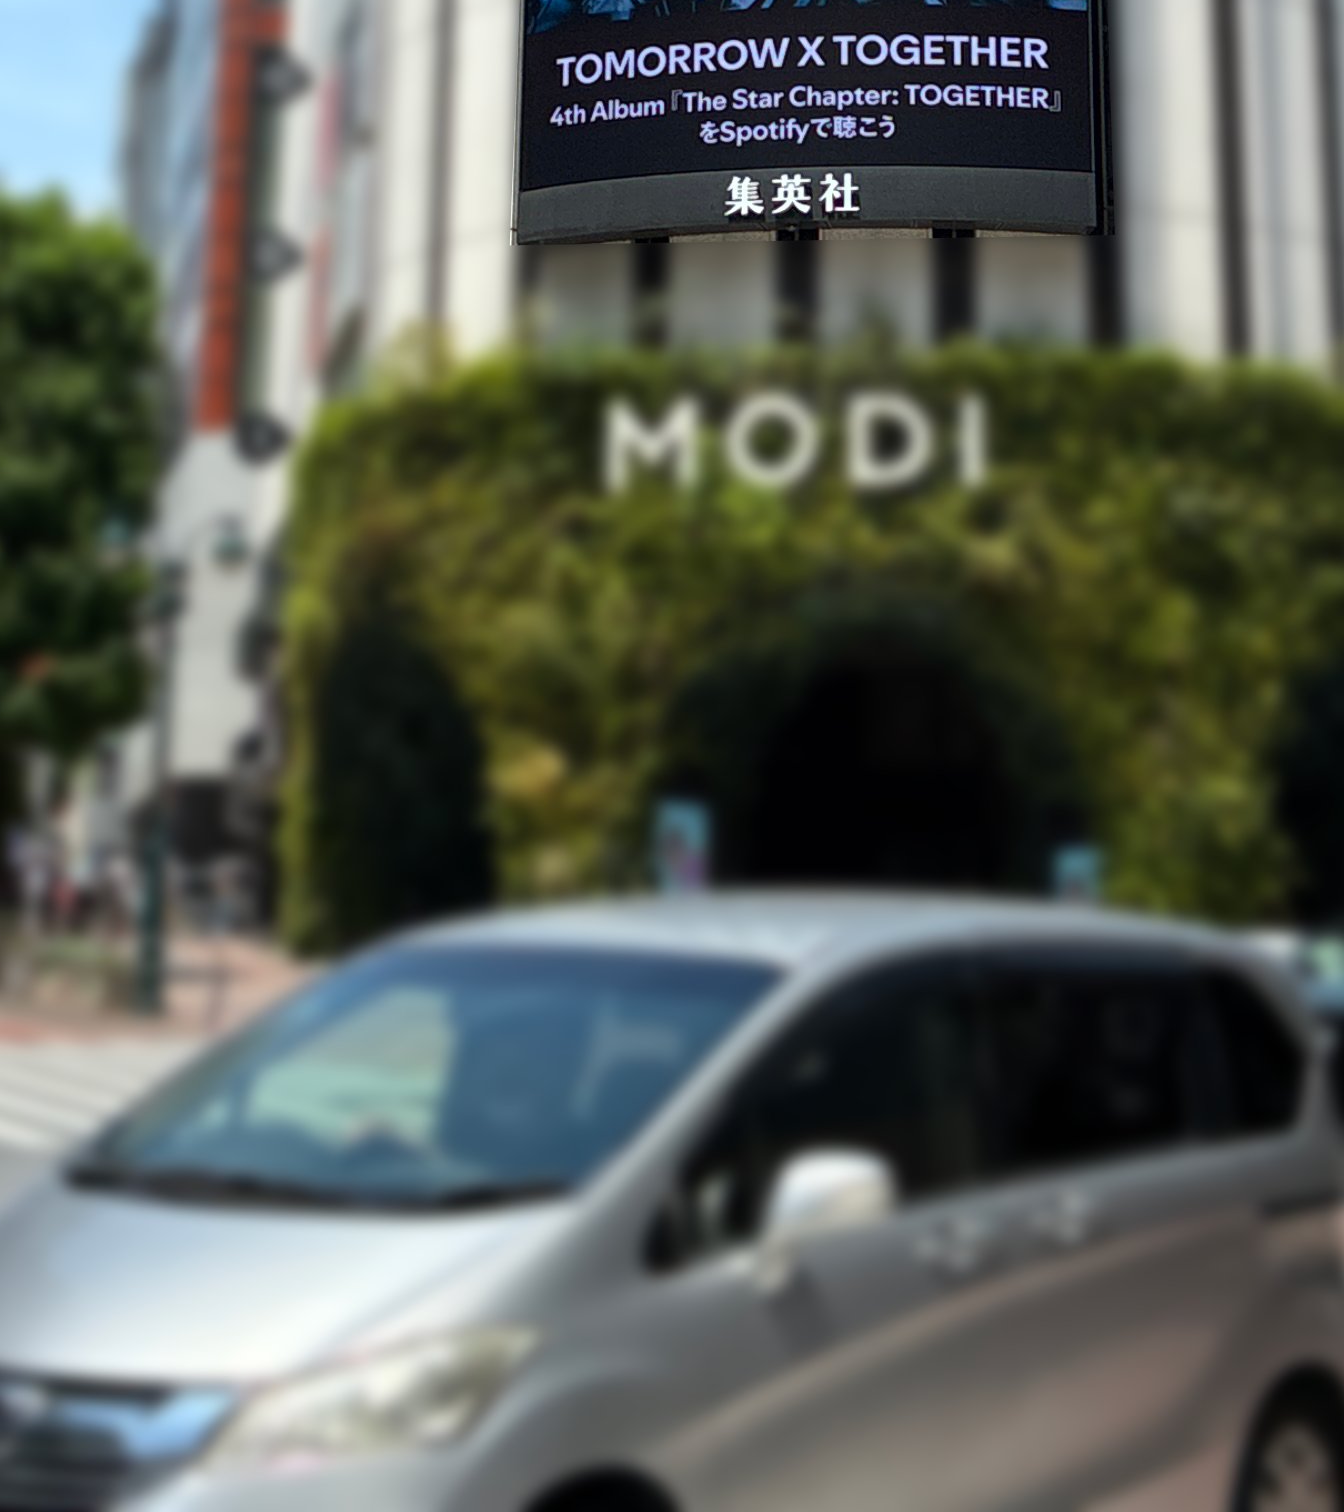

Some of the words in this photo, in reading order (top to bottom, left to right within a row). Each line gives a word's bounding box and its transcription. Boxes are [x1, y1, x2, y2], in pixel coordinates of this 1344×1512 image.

[556, 37, 790, 87] TOMORROW
[797, 36, 825, 67] X
[832, 34, 1049, 69] TOGETHER
[550, 106, 586, 127] 4th
[590, 99, 665, 123] Album
[732, 88, 784, 110] Star
[788, 85, 899, 111] Chapter:
[699, 115, 896, 147] をSpotifyで聴こう
[724, 172, 861, 216] 集英社
[604, 390, 989, 493] MODI
